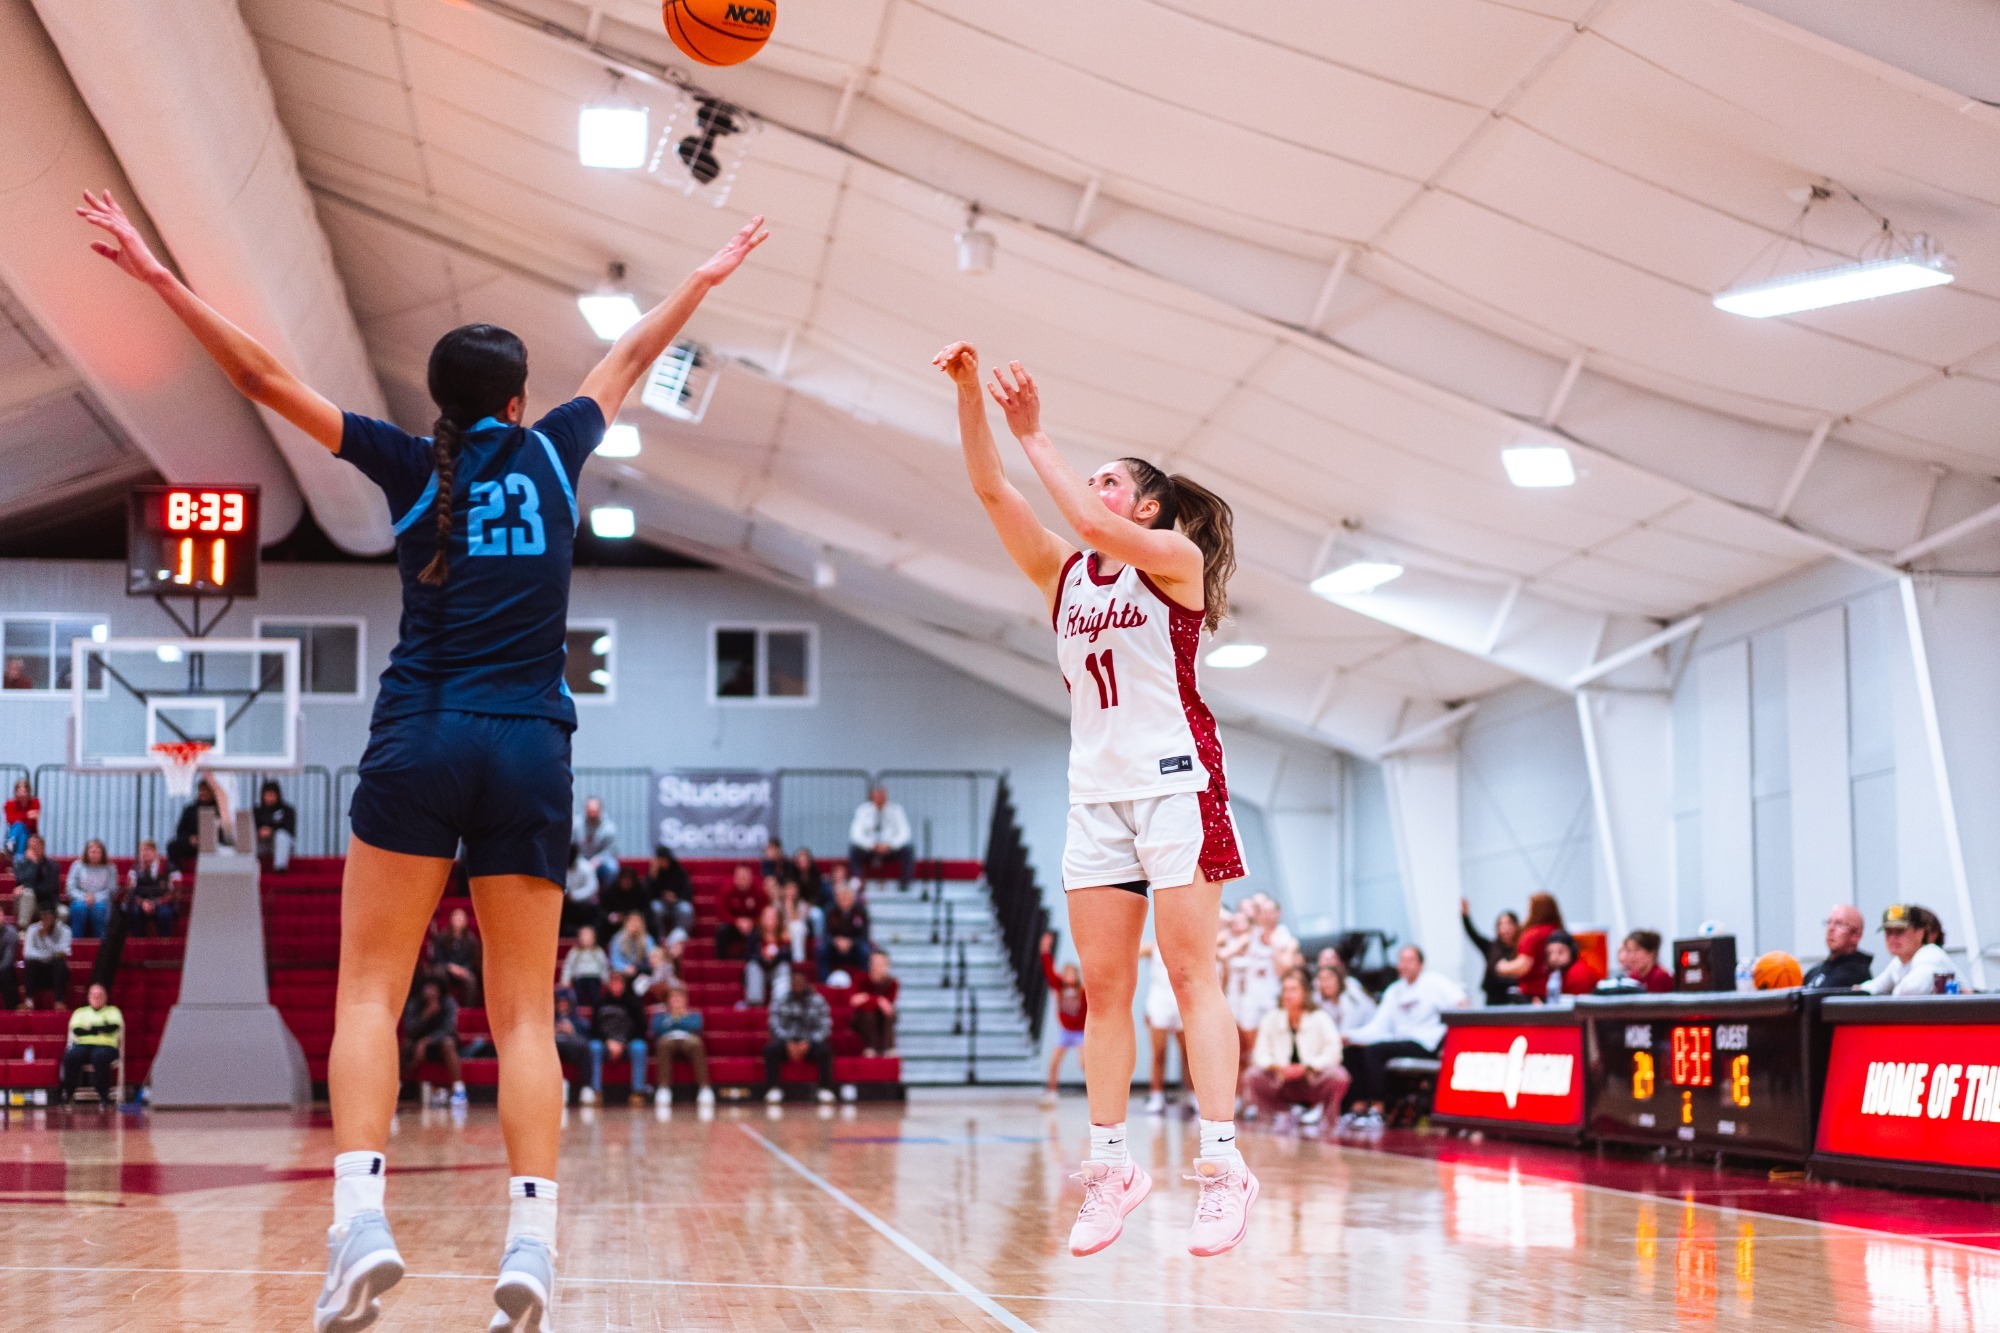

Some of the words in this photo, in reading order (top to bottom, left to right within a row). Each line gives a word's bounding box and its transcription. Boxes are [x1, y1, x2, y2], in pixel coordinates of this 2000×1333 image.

[724, 3, 771, 27] NCAA
[167, 492, 243, 532] 8:33
[467, 472, 547, 556] 23
[1064, 597, 1148, 643] Knights
[1085, 648, 1119, 709] 11
[658, 776, 771, 807] Student
[660, 817, 769, 849] Section
[1861, 1061, 1929, 1118] HOME
[1926, 1063, 1963, 1120] OF
